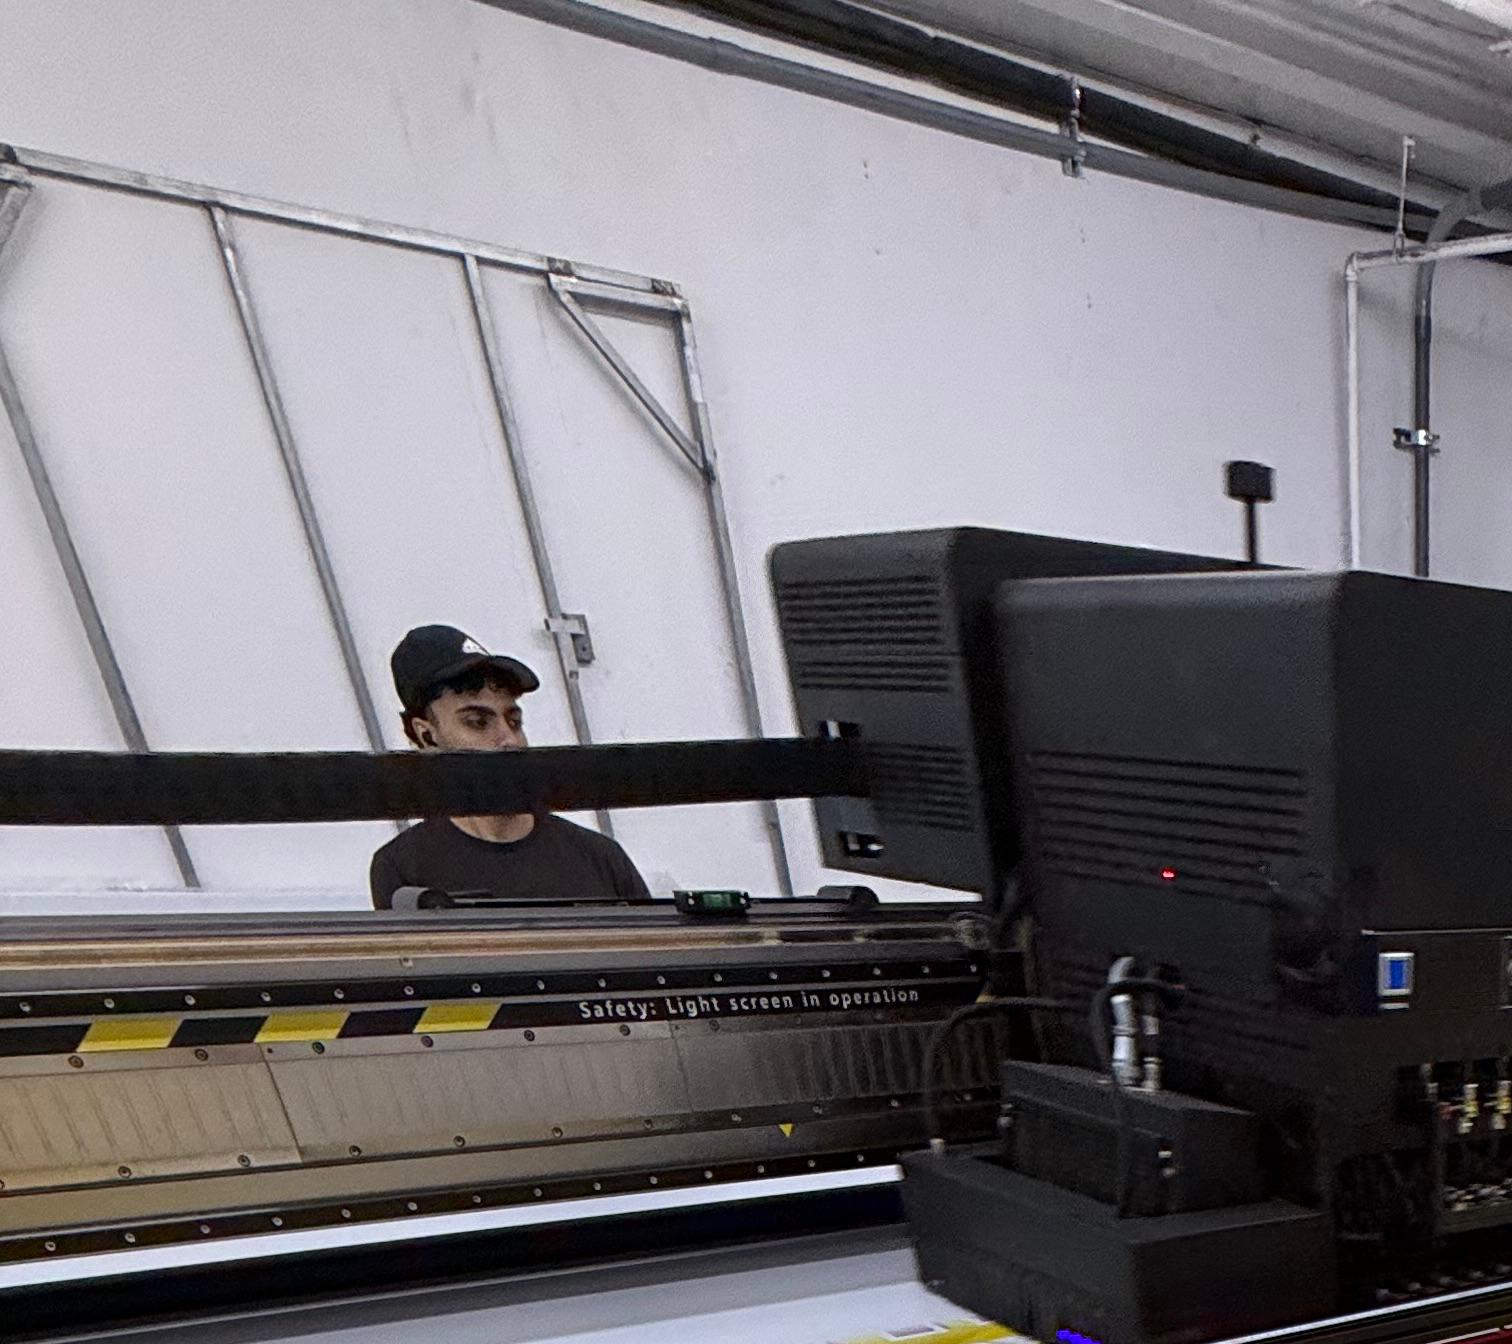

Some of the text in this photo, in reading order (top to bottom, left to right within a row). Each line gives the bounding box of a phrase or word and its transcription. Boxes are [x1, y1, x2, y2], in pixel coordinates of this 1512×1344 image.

[578, 987, 920, 1020] Safety: Light screen in operation
